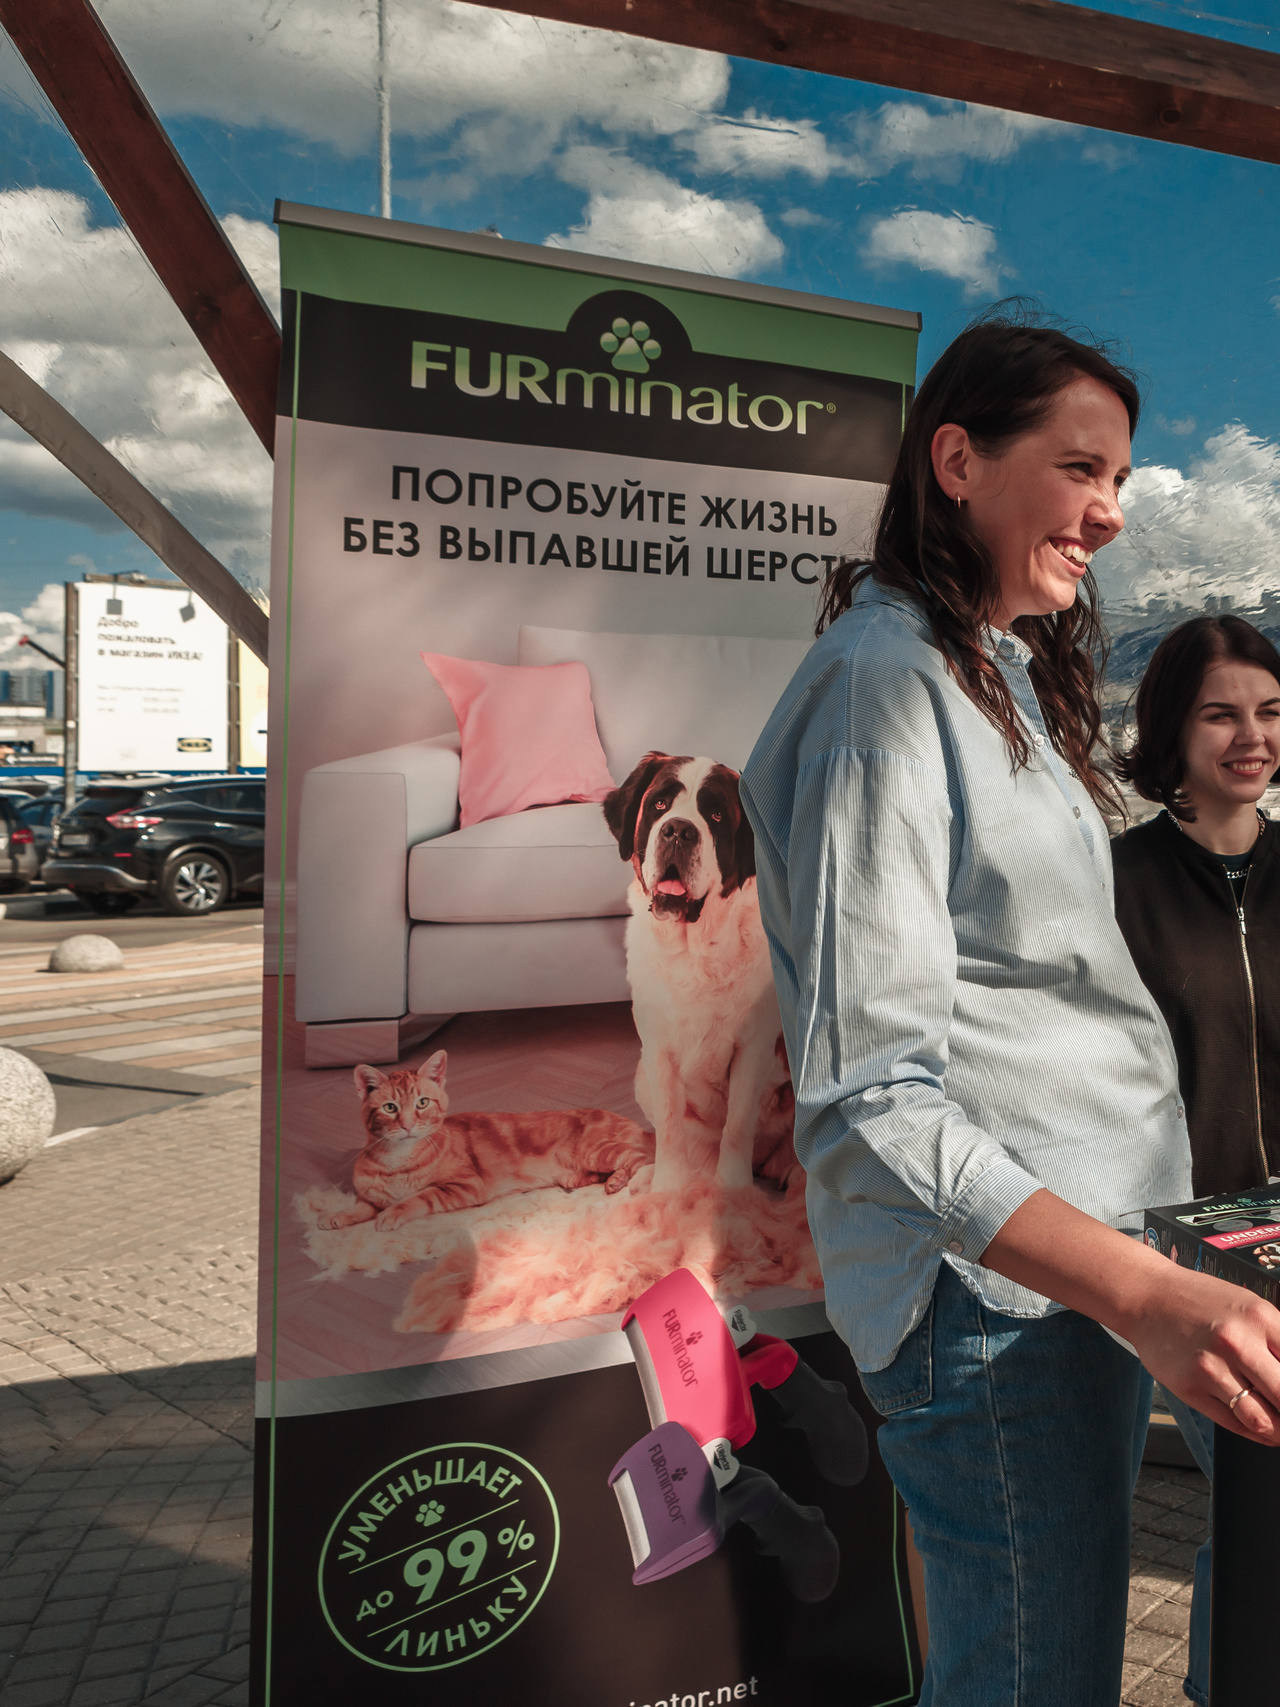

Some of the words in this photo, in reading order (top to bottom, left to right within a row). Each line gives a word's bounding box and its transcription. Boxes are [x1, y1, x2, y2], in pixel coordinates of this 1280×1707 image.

[391, 464, 687, 526] ПОПРОБУЙТЕ
[699, 495, 837, 537] ЖИЗНЬ
[343, 516, 420, 558] БЕЗ
[439, 524, 690, 577] ВЫПАВШЕЙ
[707, 546, 872, 585] ШЕРСТ
[337, 1457, 524, 1563] УМЕНЬШАЕТ
[383, 1574, 529, 1658] ЛИНЬКУ
